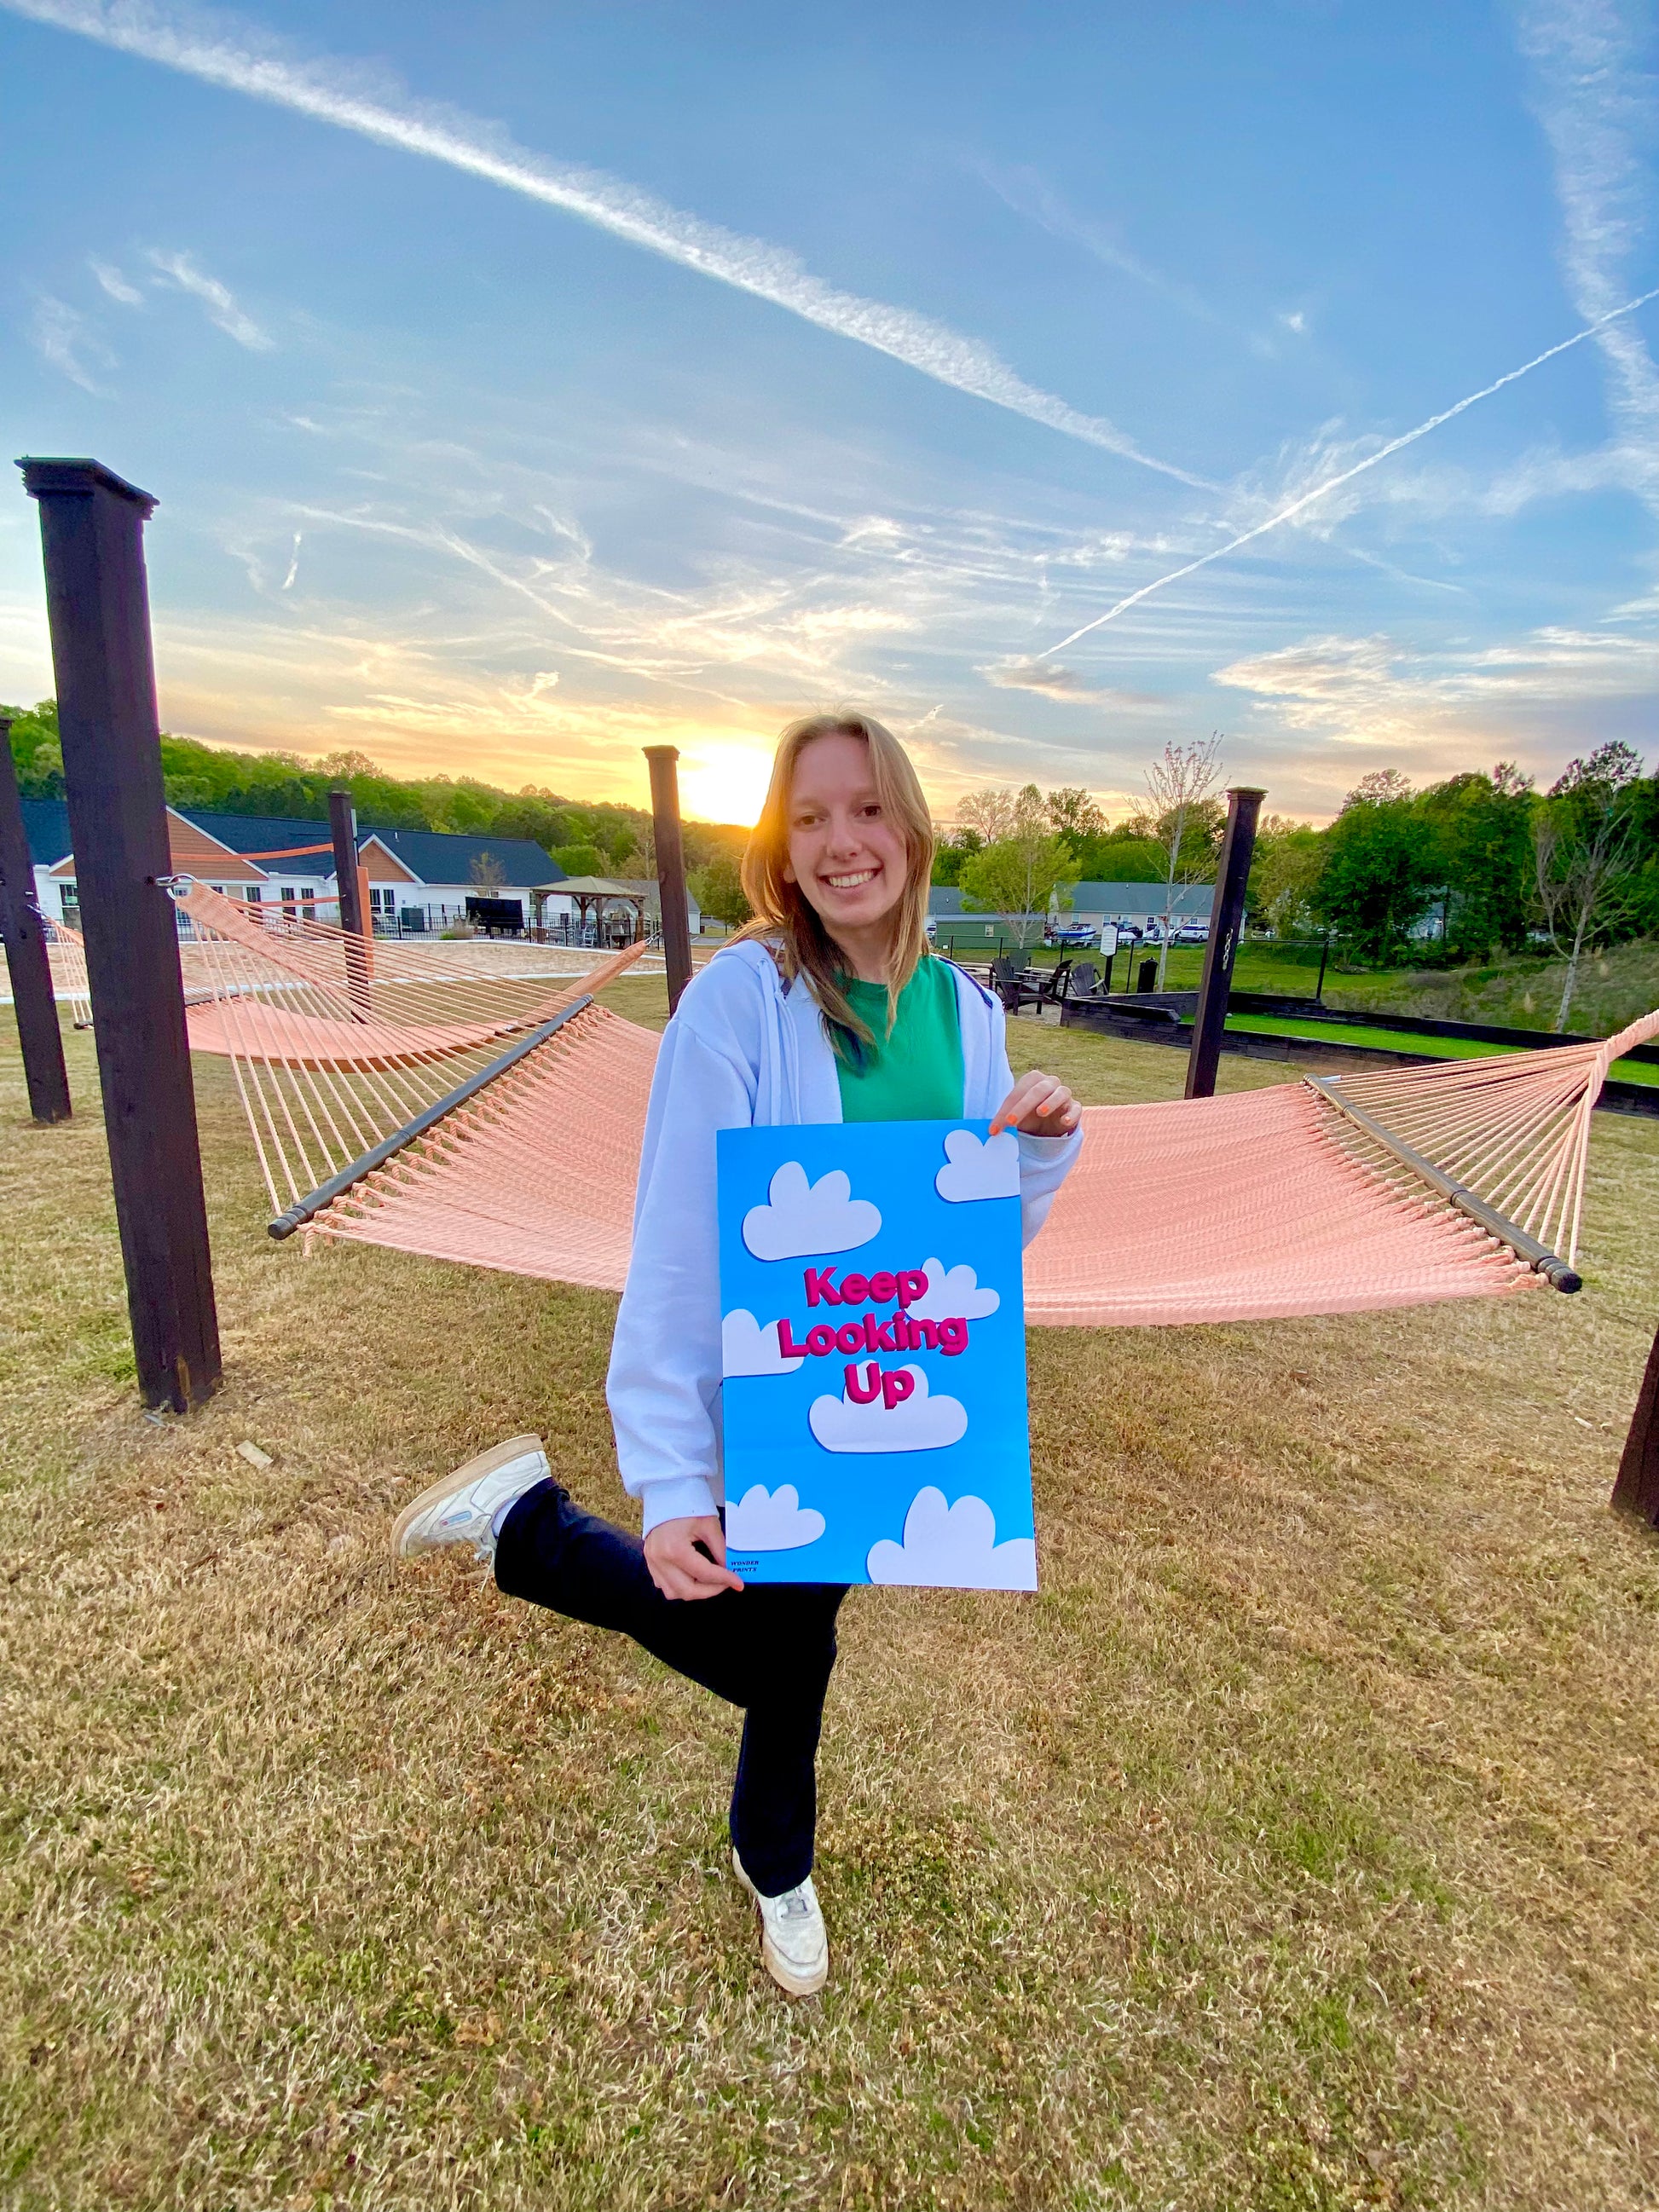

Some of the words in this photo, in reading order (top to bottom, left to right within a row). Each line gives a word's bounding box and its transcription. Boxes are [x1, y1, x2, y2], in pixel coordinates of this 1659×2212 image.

[804, 1267, 928, 1308] Keep
[777, 1312, 968, 1358] Looking
[844, 1362, 915, 1410] Up
